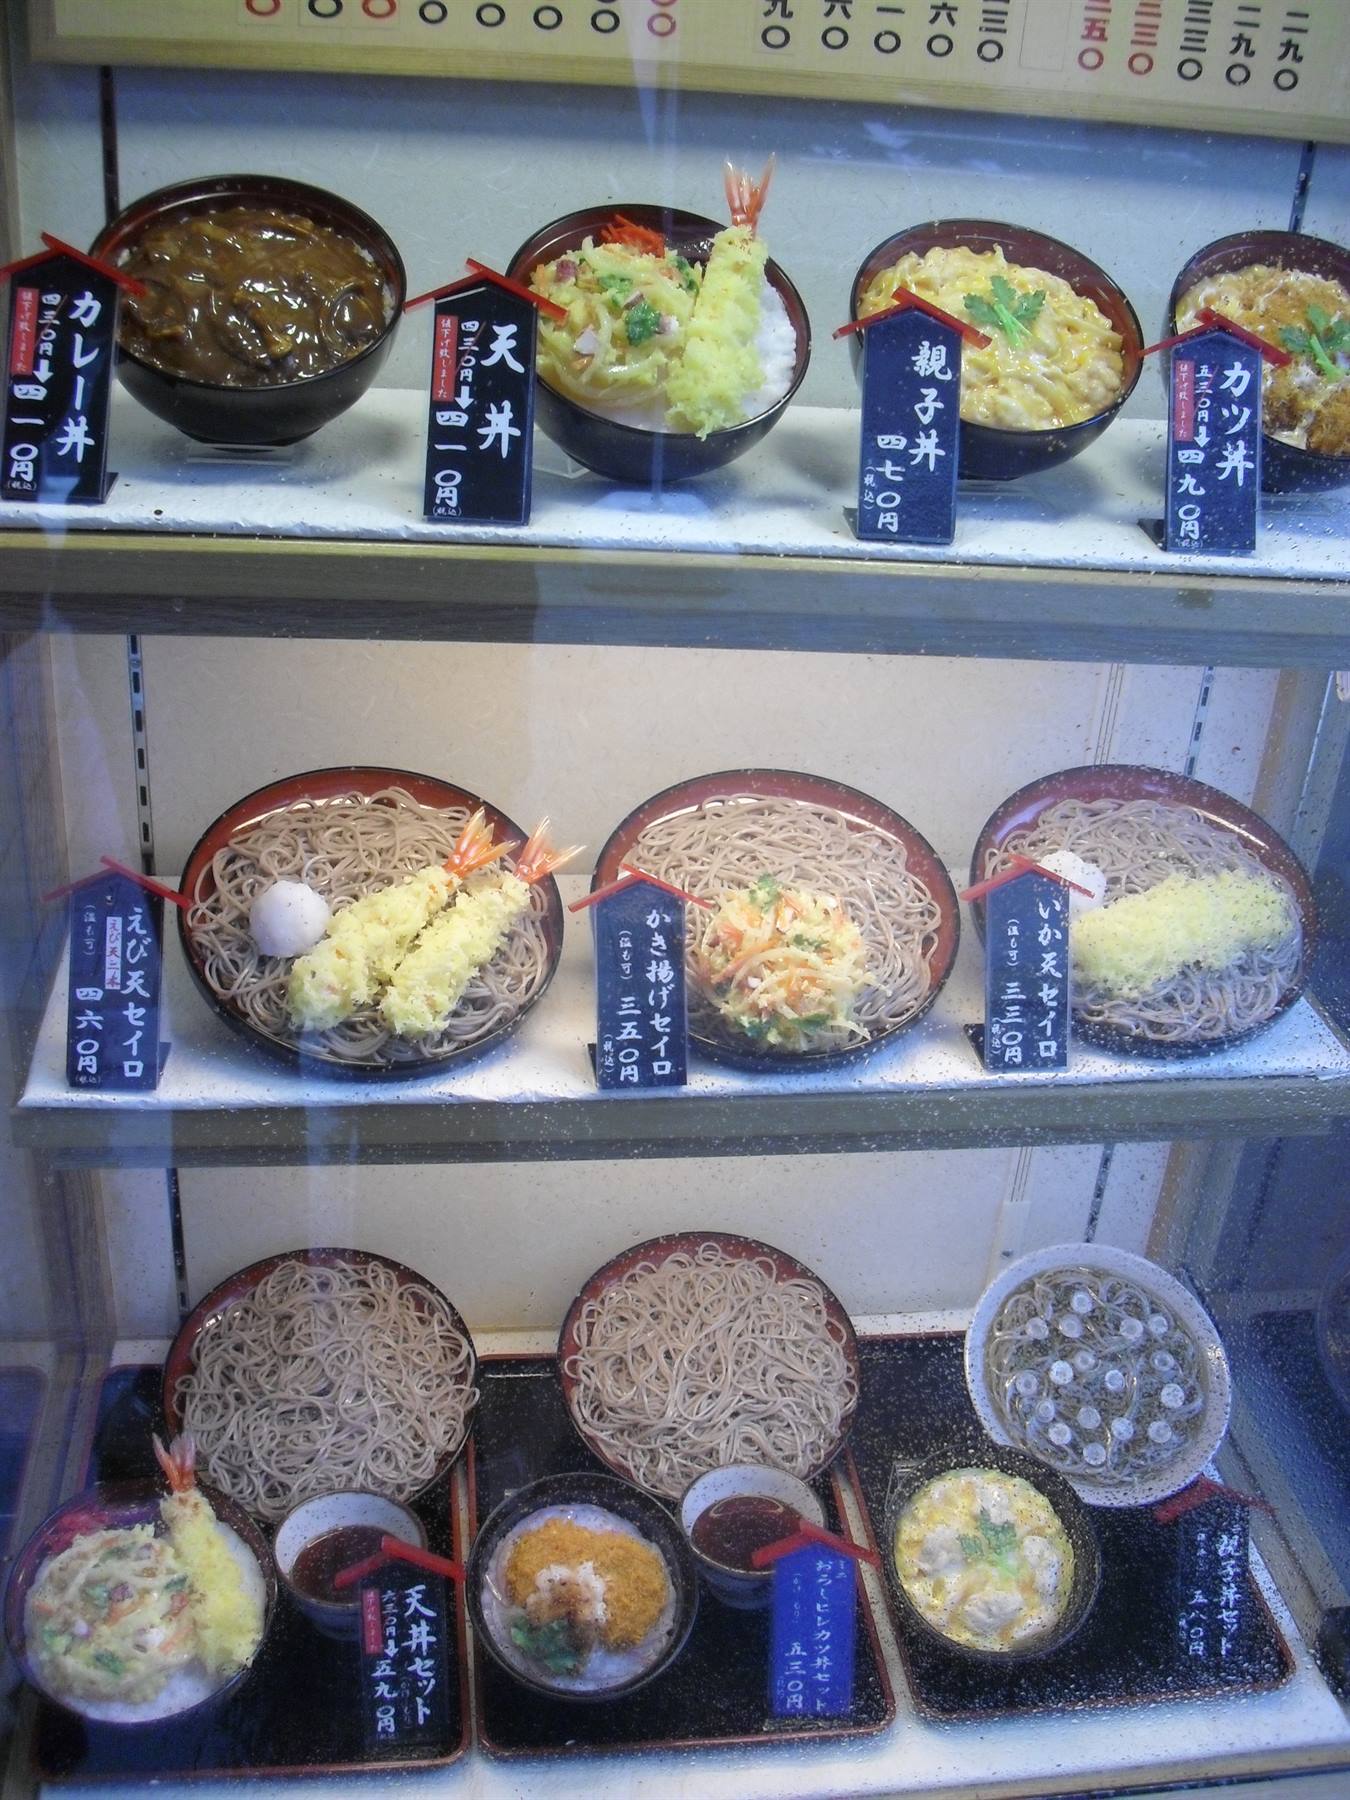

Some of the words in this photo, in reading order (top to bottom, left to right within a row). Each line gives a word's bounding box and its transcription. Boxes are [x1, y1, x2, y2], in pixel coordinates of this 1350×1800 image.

[9, 383, 47, 483] 四一〇円
[55, 290, 102, 463] カレー丼
[476, 323, 525, 460] 天丼
[907, 340, 953, 473] 親子丼
[1215, 361, 1255, 488] カツ丼
[433, 410, 469, 509] 四一〇円
[875, 433, 908, 534] 四七〇円
[1176, 449, 1206, 541] 四九〇円
[75, 986, 105, 1075] 四六〇円
[119, 906, 152, 1079] えび天セイロ
[615, 996, 643, 1084] 三五〇円
[645, 909, 676, 1077] かき揚げセイロ
[1036, 899, 1063, 1059] いか天セイロ
[401, 1584, 438, 1726] 天丼セット
